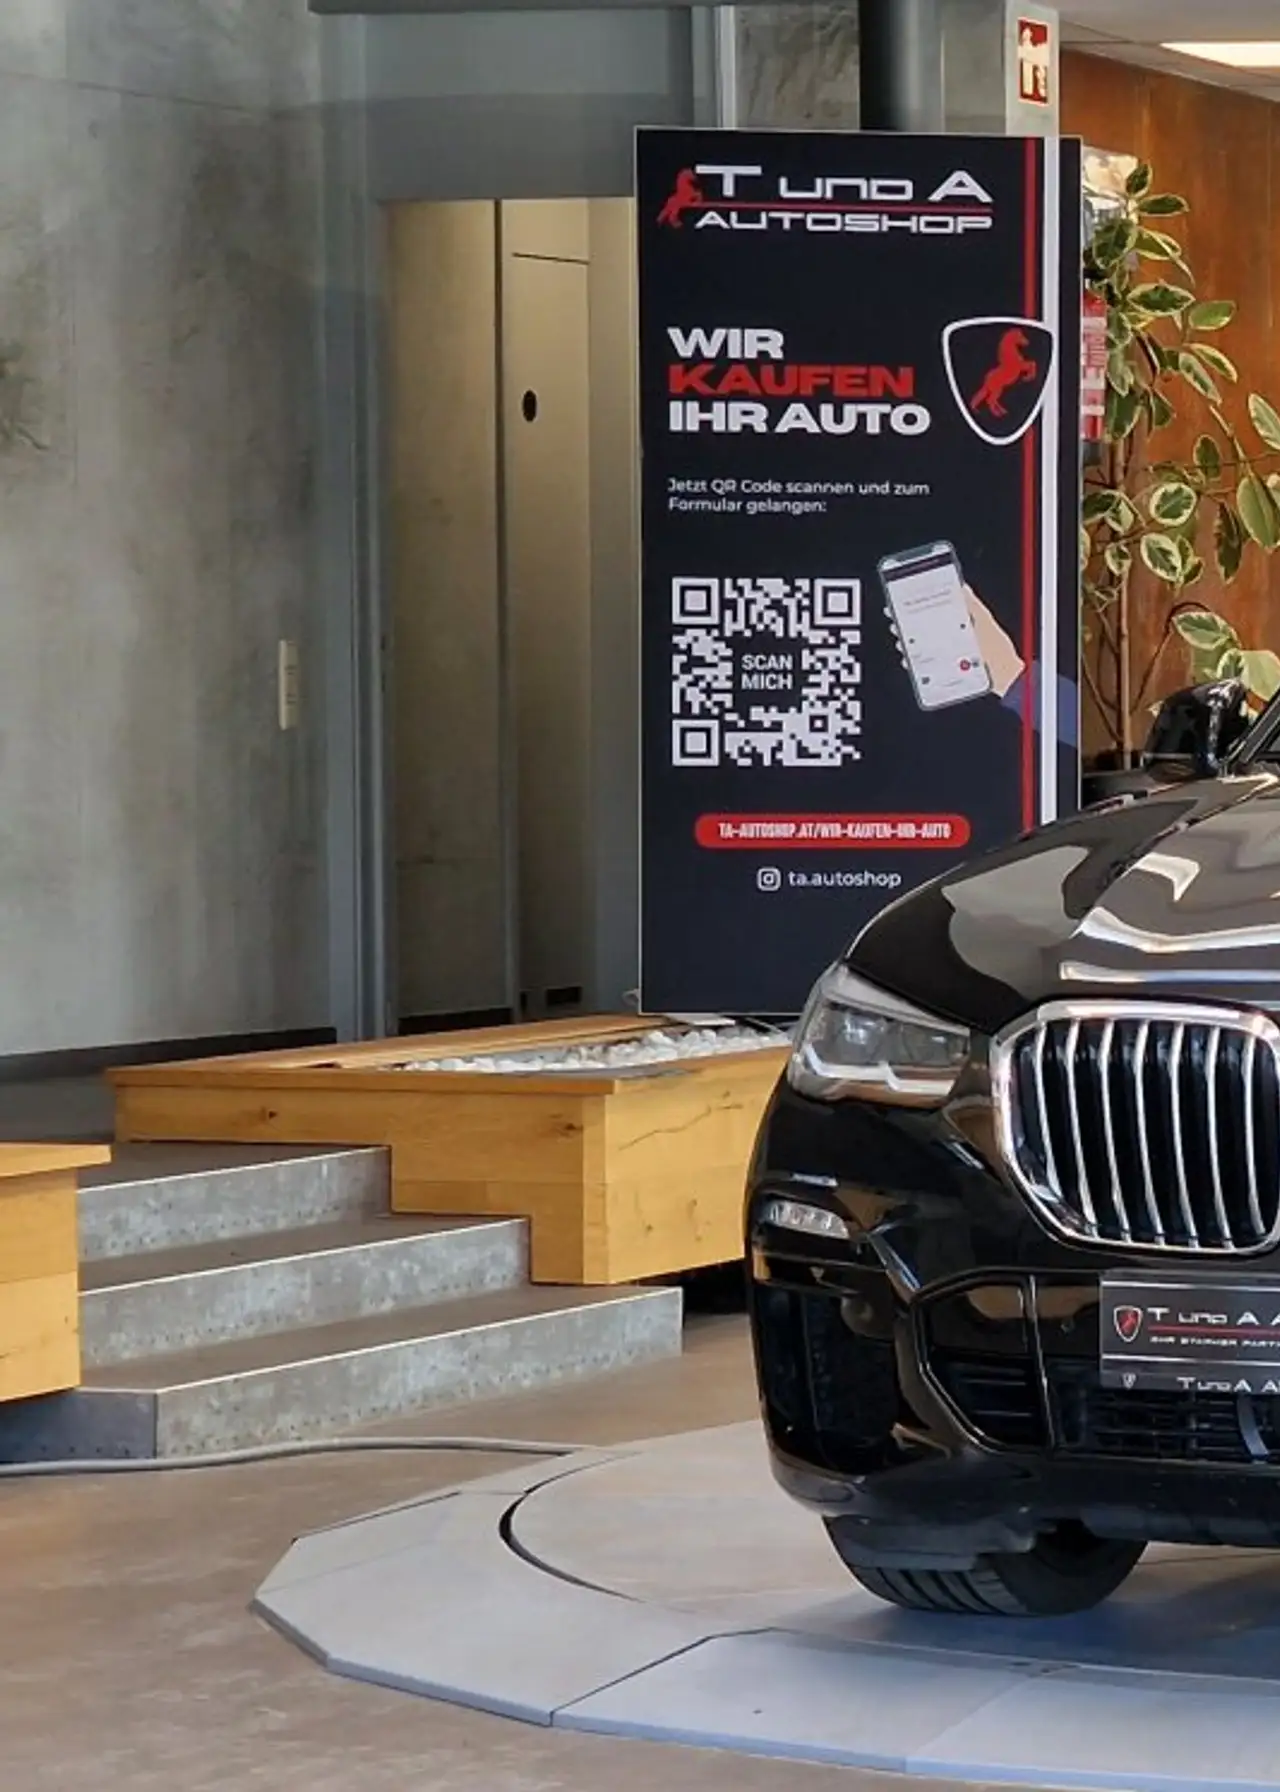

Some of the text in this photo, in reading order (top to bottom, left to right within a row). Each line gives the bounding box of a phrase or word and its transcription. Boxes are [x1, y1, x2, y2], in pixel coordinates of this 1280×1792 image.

[695, 165, 762, 197] T
[927, 171, 993, 203] A
[695, 211, 993, 234] AUTOSHOP
[667, 328, 784, 360] WIR
[669, 365, 913, 398] KAUFEN
[669, 401, 931, 436] IHR AUTO
[667, 478, 930, 496] Jetzt QR Code scannen und zum
[668, 494, 827, 516] Formular gelangen:
[741, 655, 793, 671] SCAN
[741, 674, 793, 690] MICH
[787, 871, 902, 889] ta.autoshop
[1147, 1308, 1169, 1321] T
[1236, 1312, 1260, 1326] A
